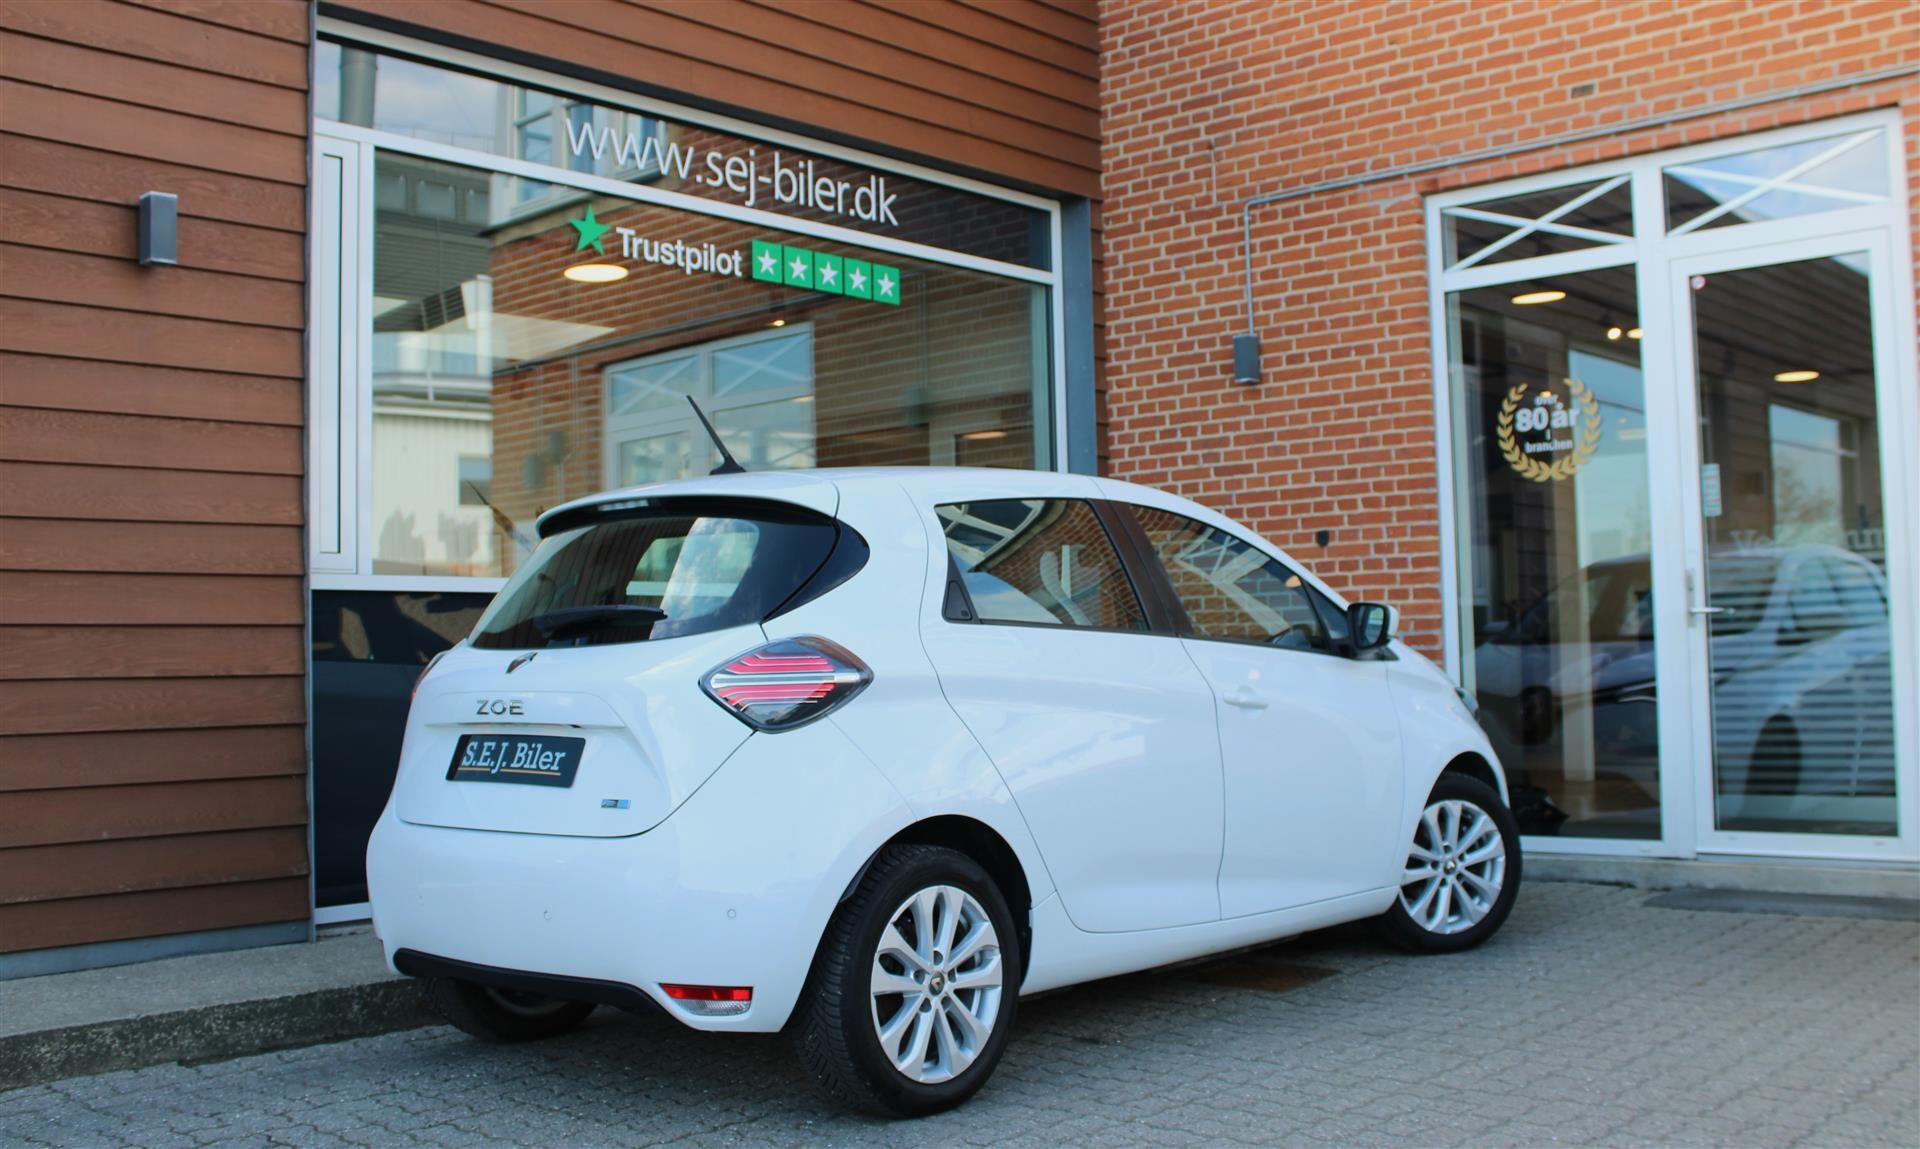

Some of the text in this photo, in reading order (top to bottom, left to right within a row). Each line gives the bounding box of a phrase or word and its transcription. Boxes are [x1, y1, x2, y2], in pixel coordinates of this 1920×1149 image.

[565, 118, 899, 226] www.sej-biler.dk
[616, 226, 743, 277] Trustpilot
[1516, 402, 1580, 431] 80 år
[1525, 440, 1573, 453] branchen
[476, 699, 525, 716] ZOE
[461, 741, 566, 774] S.E.J. Biler
